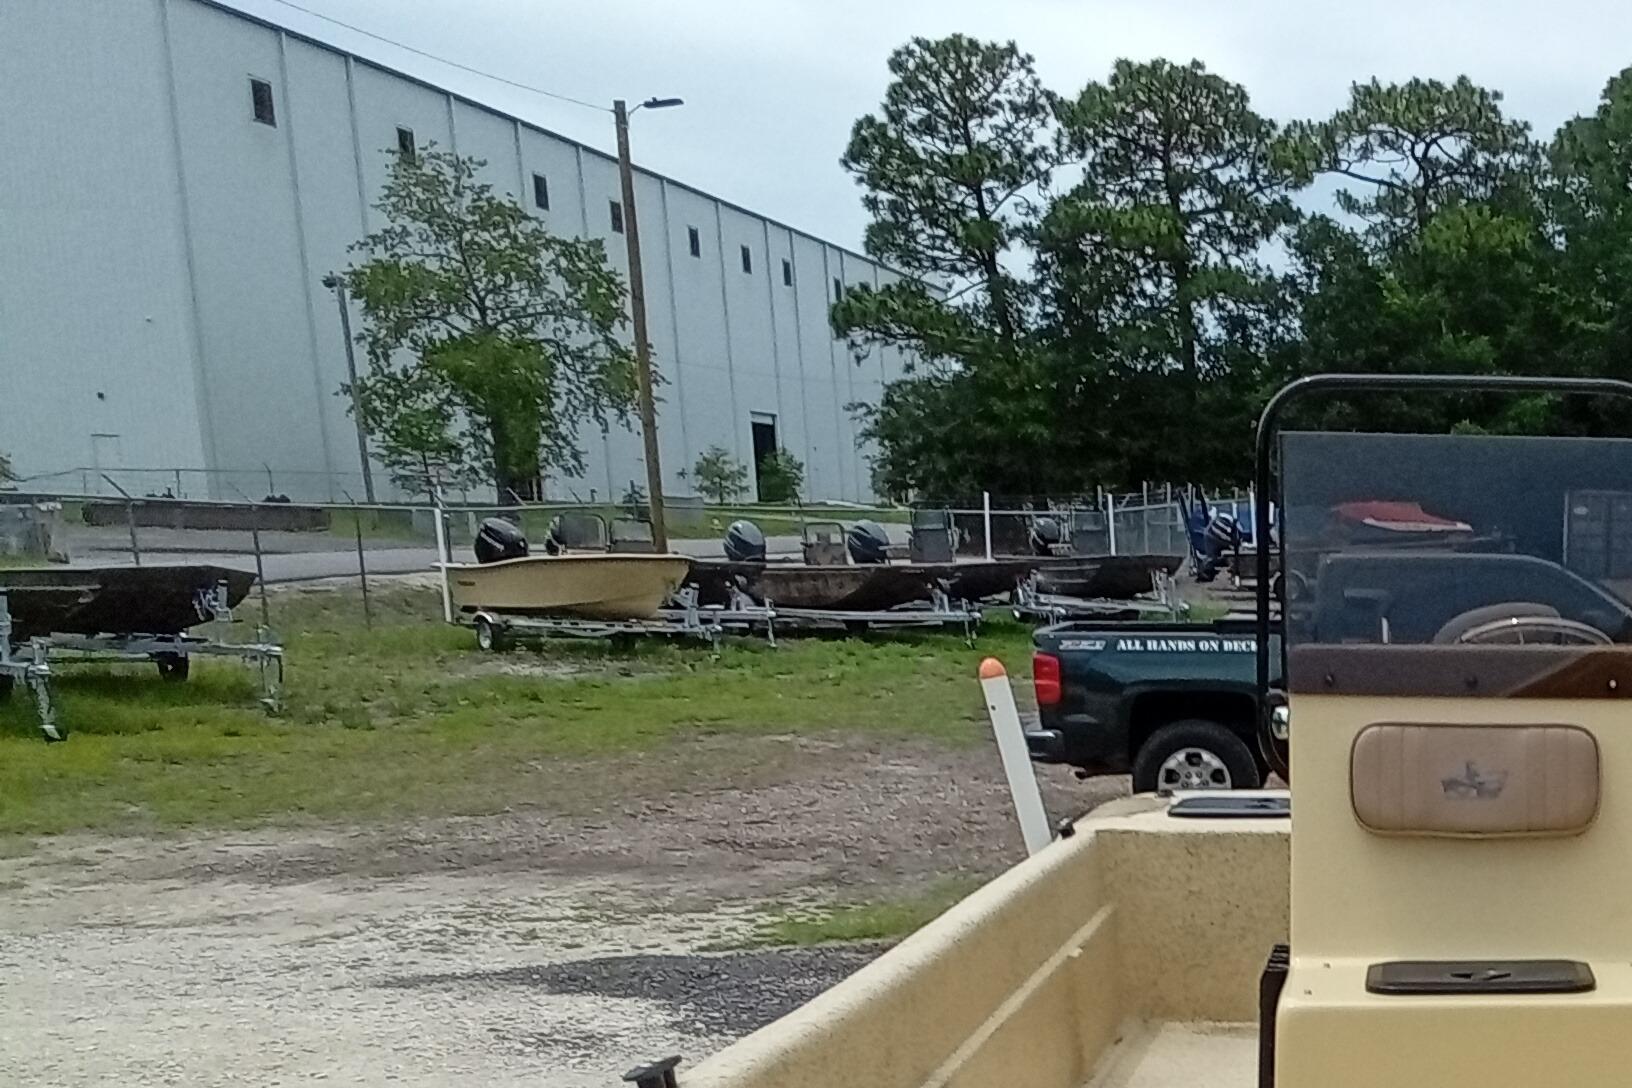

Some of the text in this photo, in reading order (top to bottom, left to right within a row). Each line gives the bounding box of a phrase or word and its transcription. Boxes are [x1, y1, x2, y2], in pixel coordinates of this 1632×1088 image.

[1116, 639, 1145, 651] ALL
[1146, 639, 1196, 651] HANDS
[1198, 639, 1220, 652] ON
